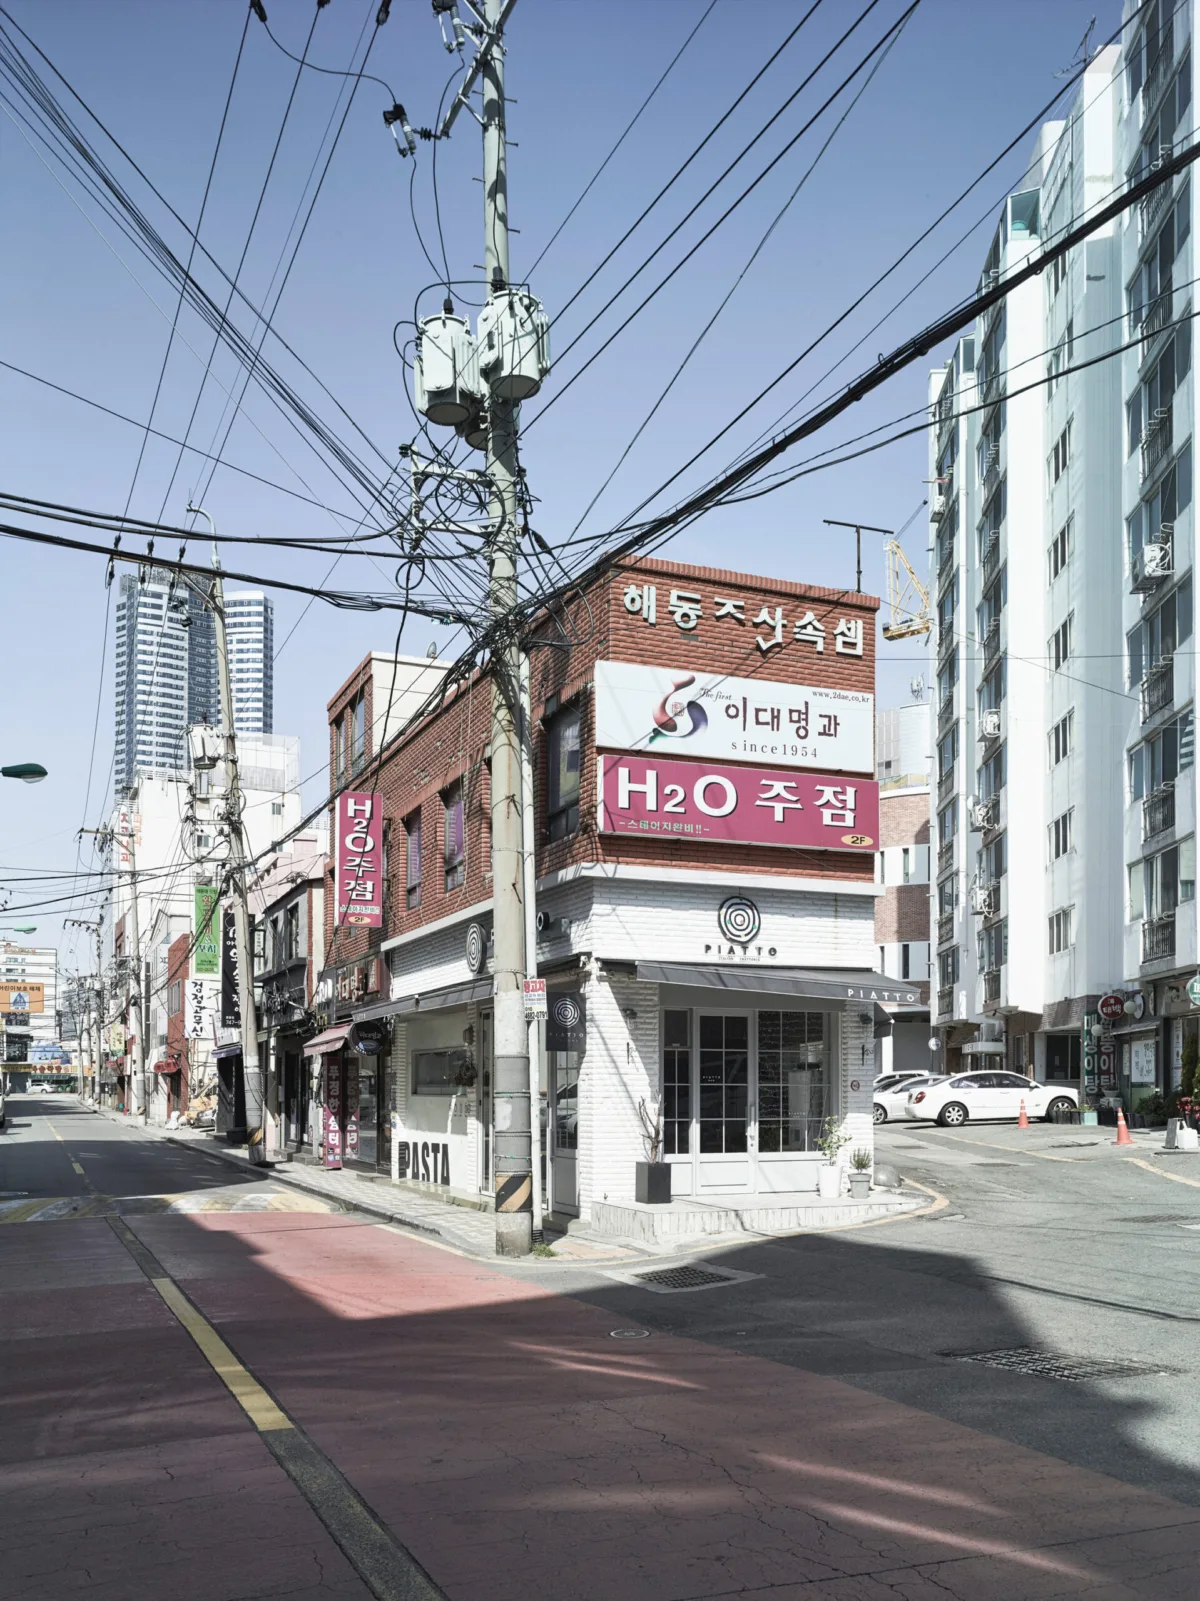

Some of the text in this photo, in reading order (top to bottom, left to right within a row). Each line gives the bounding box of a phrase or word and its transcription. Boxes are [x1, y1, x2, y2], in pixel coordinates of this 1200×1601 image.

[713, 690, 732, 702] first
[812, 691, 870, 703] www.2dae.co.kr
[725, 696, 840, 740] 이대명과
[617, 766, 859, 828] H2O 주점
[851, 836, 866, 845] 2F
[343, 798, 377, 902] H2O 주점
[704, 944, 778, 957] PIATTO
[848, 988, 915, 1002] PIATTO
[398, 1141, 451, 1187] PASTA
